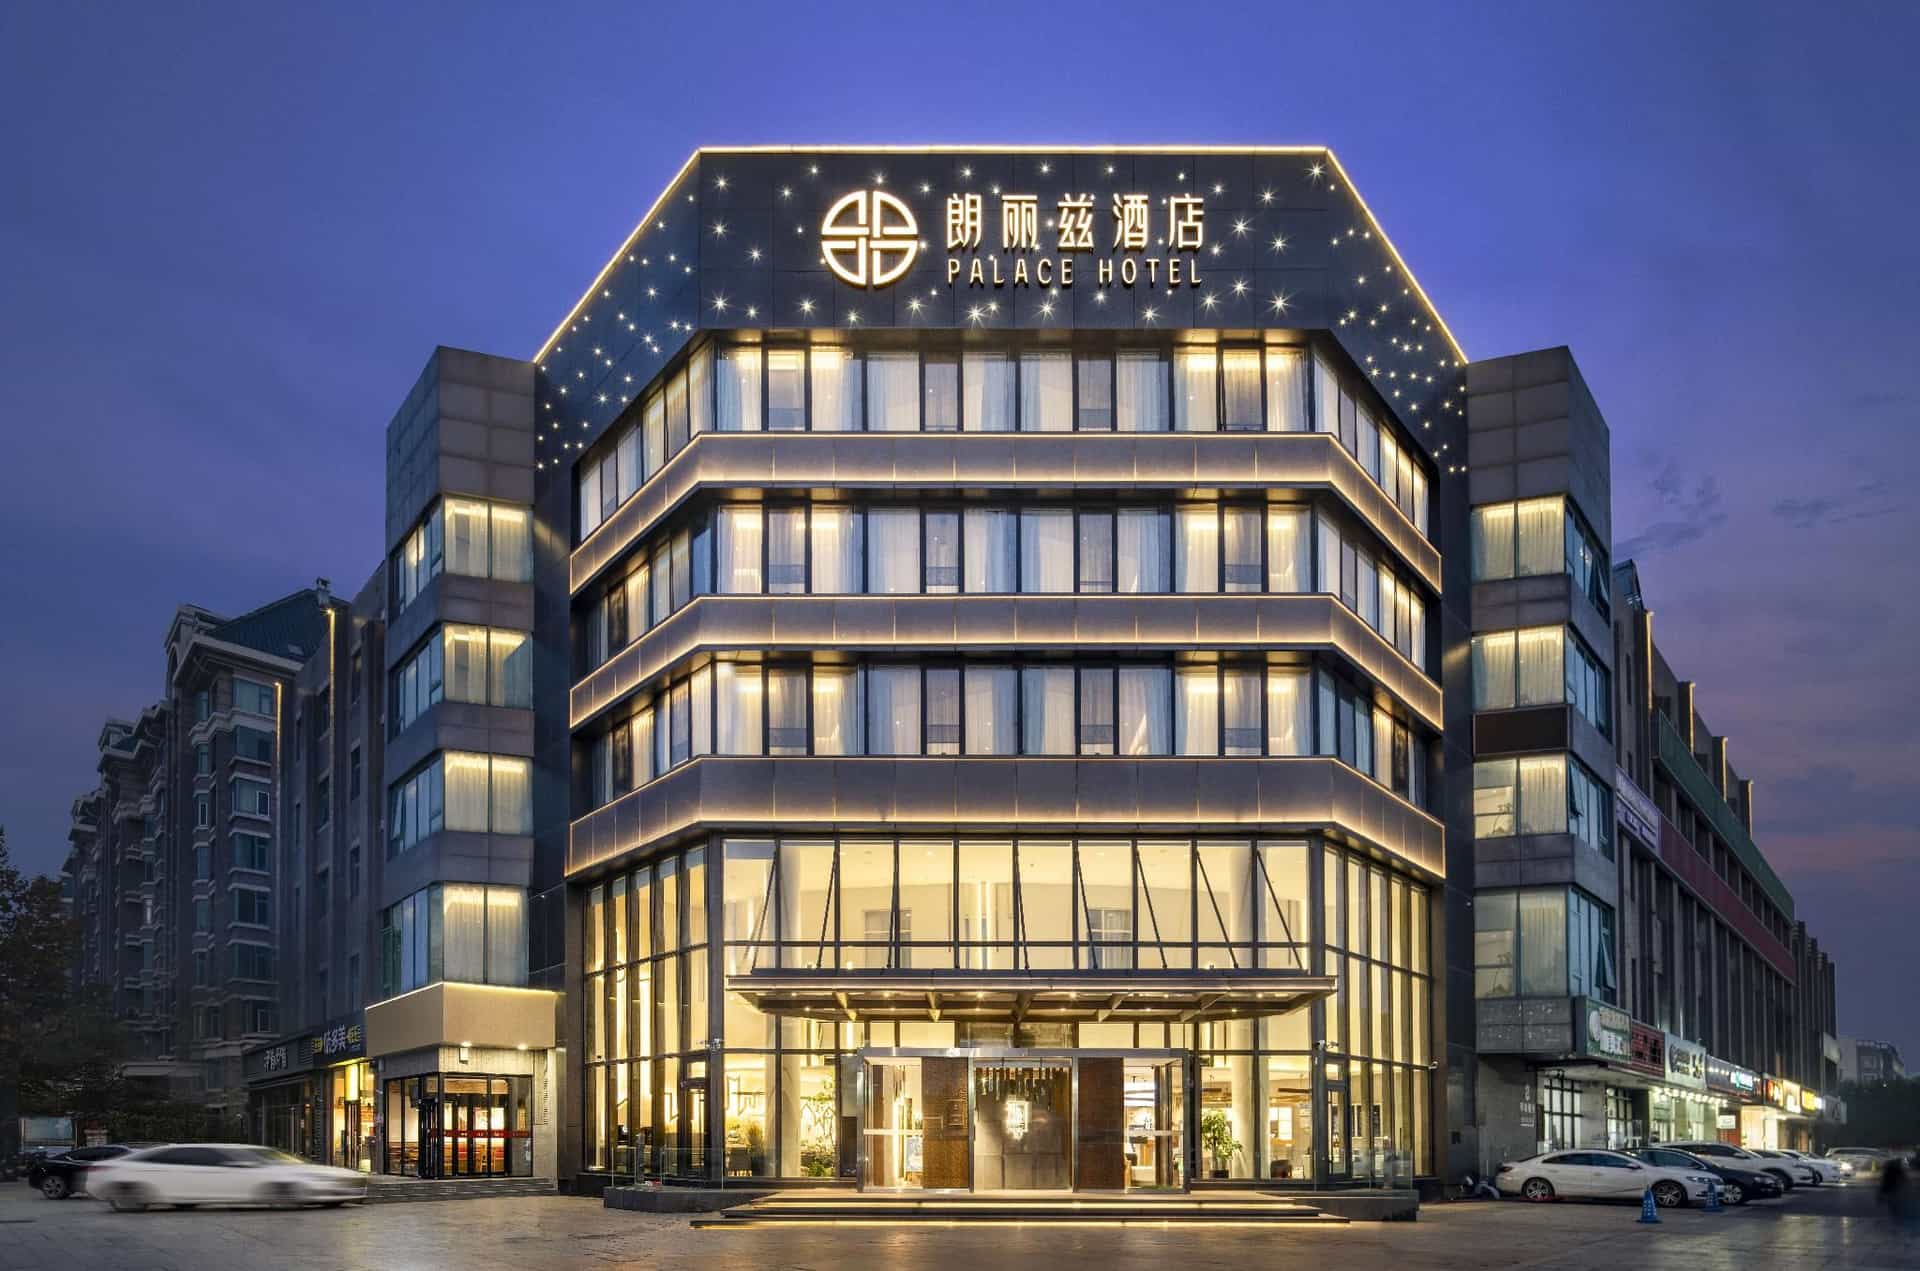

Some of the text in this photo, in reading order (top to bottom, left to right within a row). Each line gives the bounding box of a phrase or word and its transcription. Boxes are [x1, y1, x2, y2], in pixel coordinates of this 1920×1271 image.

[946, 192, 1205, 249] 朗丽兹酒店
[947, 257, 1203, 285] PALACE HOTEL
